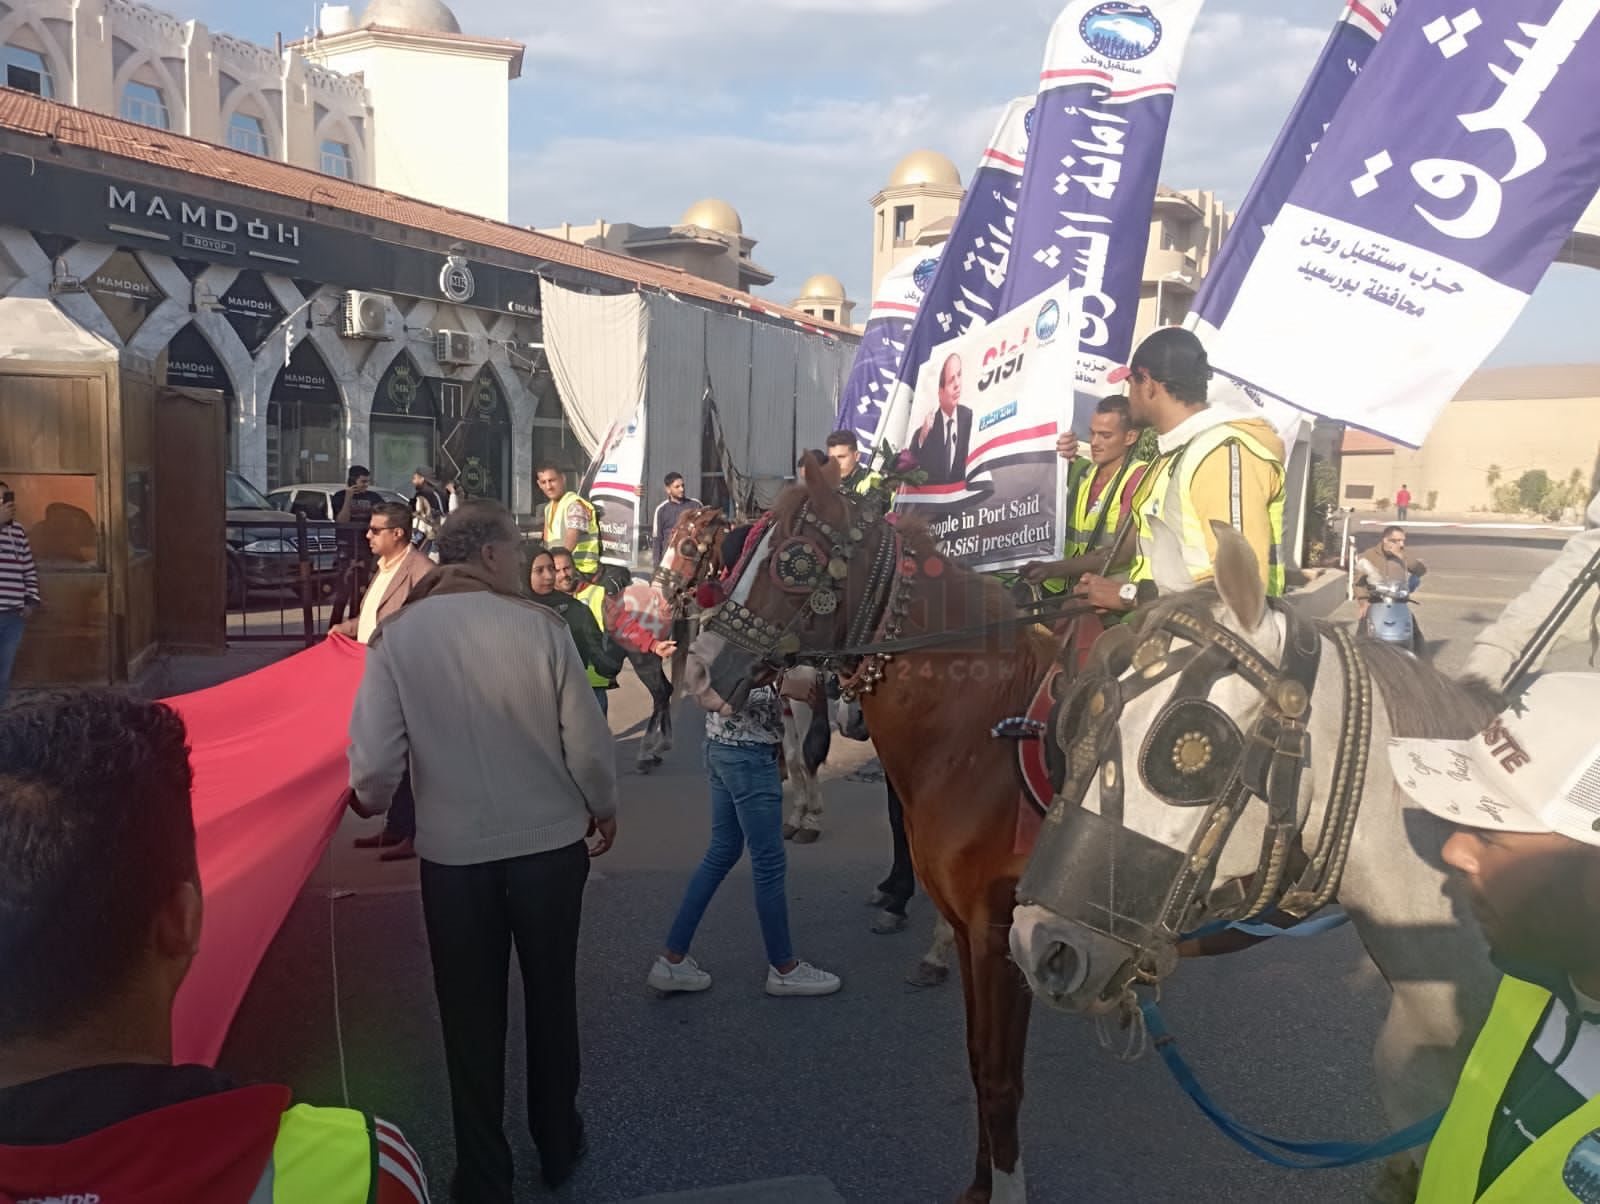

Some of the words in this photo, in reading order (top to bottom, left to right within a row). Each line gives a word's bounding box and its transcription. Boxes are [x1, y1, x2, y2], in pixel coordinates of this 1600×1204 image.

[1081, 55, 1103, 68] وطن
[1103, 60, 1142, 74] مستقبل
[1053, 105, 1128, 200] أمانة
[1300, 227, 1340, 254] وطن
[1339, 241, 1406, 272] مستقبل
[1297, 261, 1361, 297] بورسعيد
[1410, 267, 1464, 294] حزب
[1362, 278, 1425, 318] محافظة
[928, 514, 959, 540] eople
[962, 512, 975, 529] in
[978, 503, 1007, 526] Port
[1009, 494, 1040, 520] Said
[942, 534, 980, 558] l-SiSi
[982, 521, 1050, 555] presedent
[1482, 718, 1531, 774] STE
